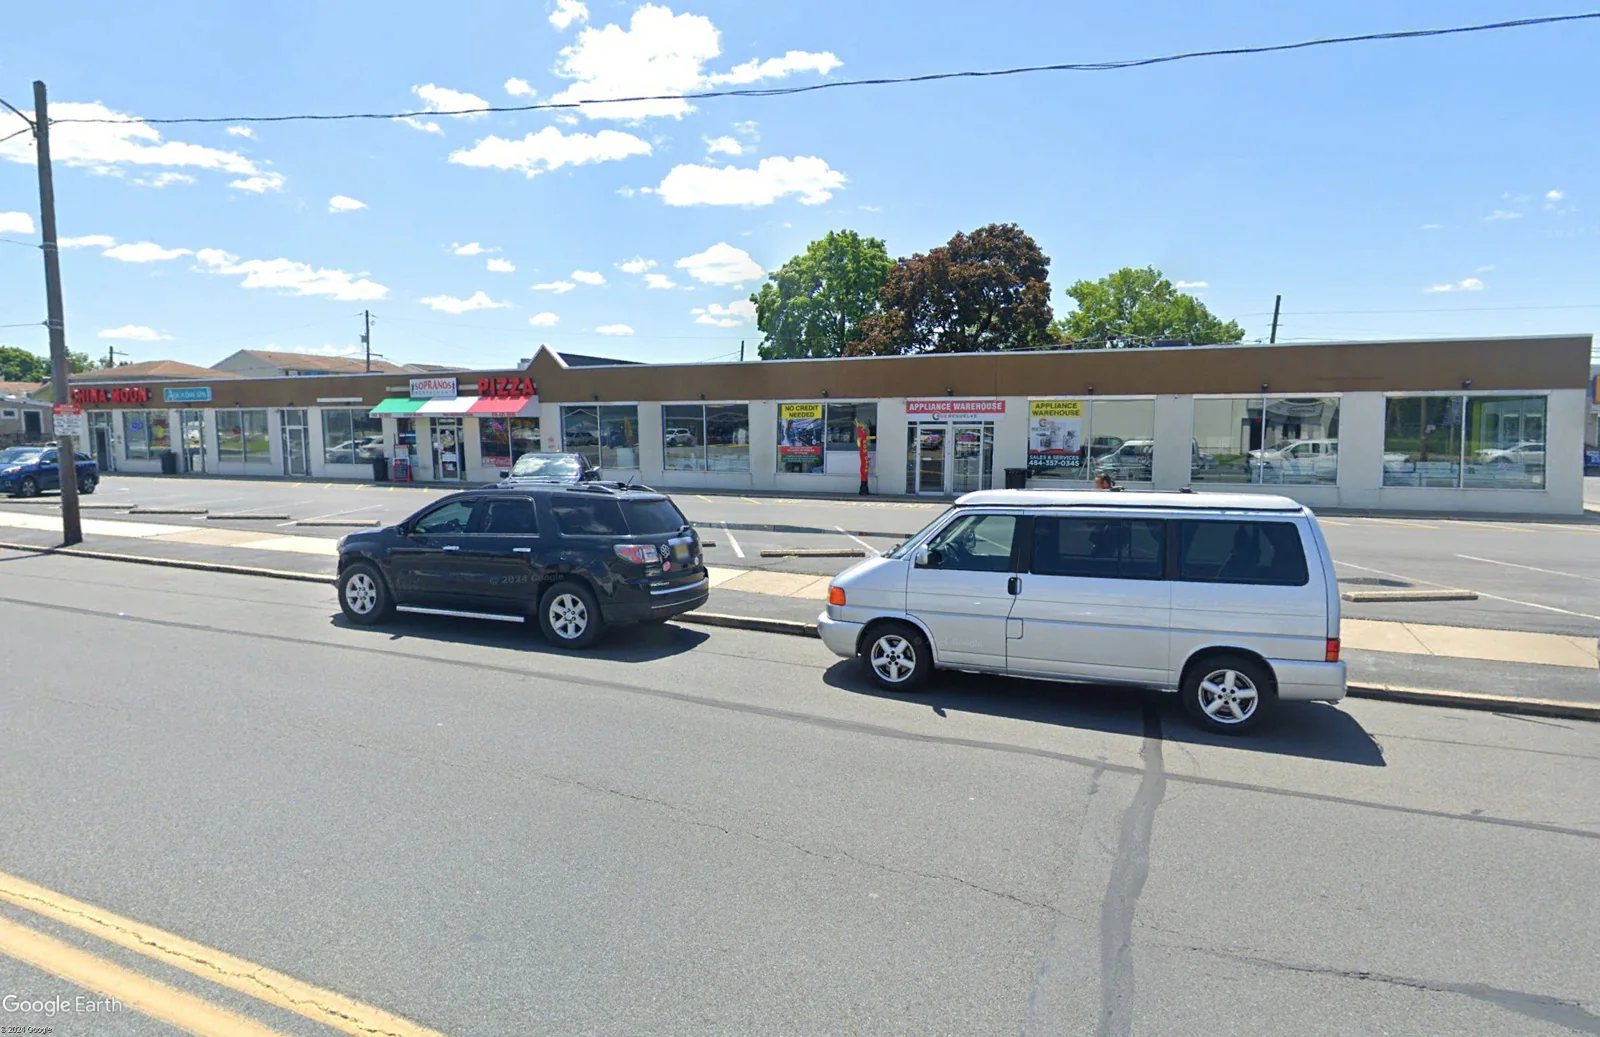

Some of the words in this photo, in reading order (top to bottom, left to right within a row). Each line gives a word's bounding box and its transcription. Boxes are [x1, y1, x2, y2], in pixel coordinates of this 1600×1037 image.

[414, 380, 452, 390] SOPRANOS
[478, 377, 535, 396] PIZZA
[71, 388, 108, 404] CHINA
[111, 386, 148, 404] MOON
[909, 402, 951, 411] APPLIANCE
[953, 402, 1002, 411] WAREHOUSE
